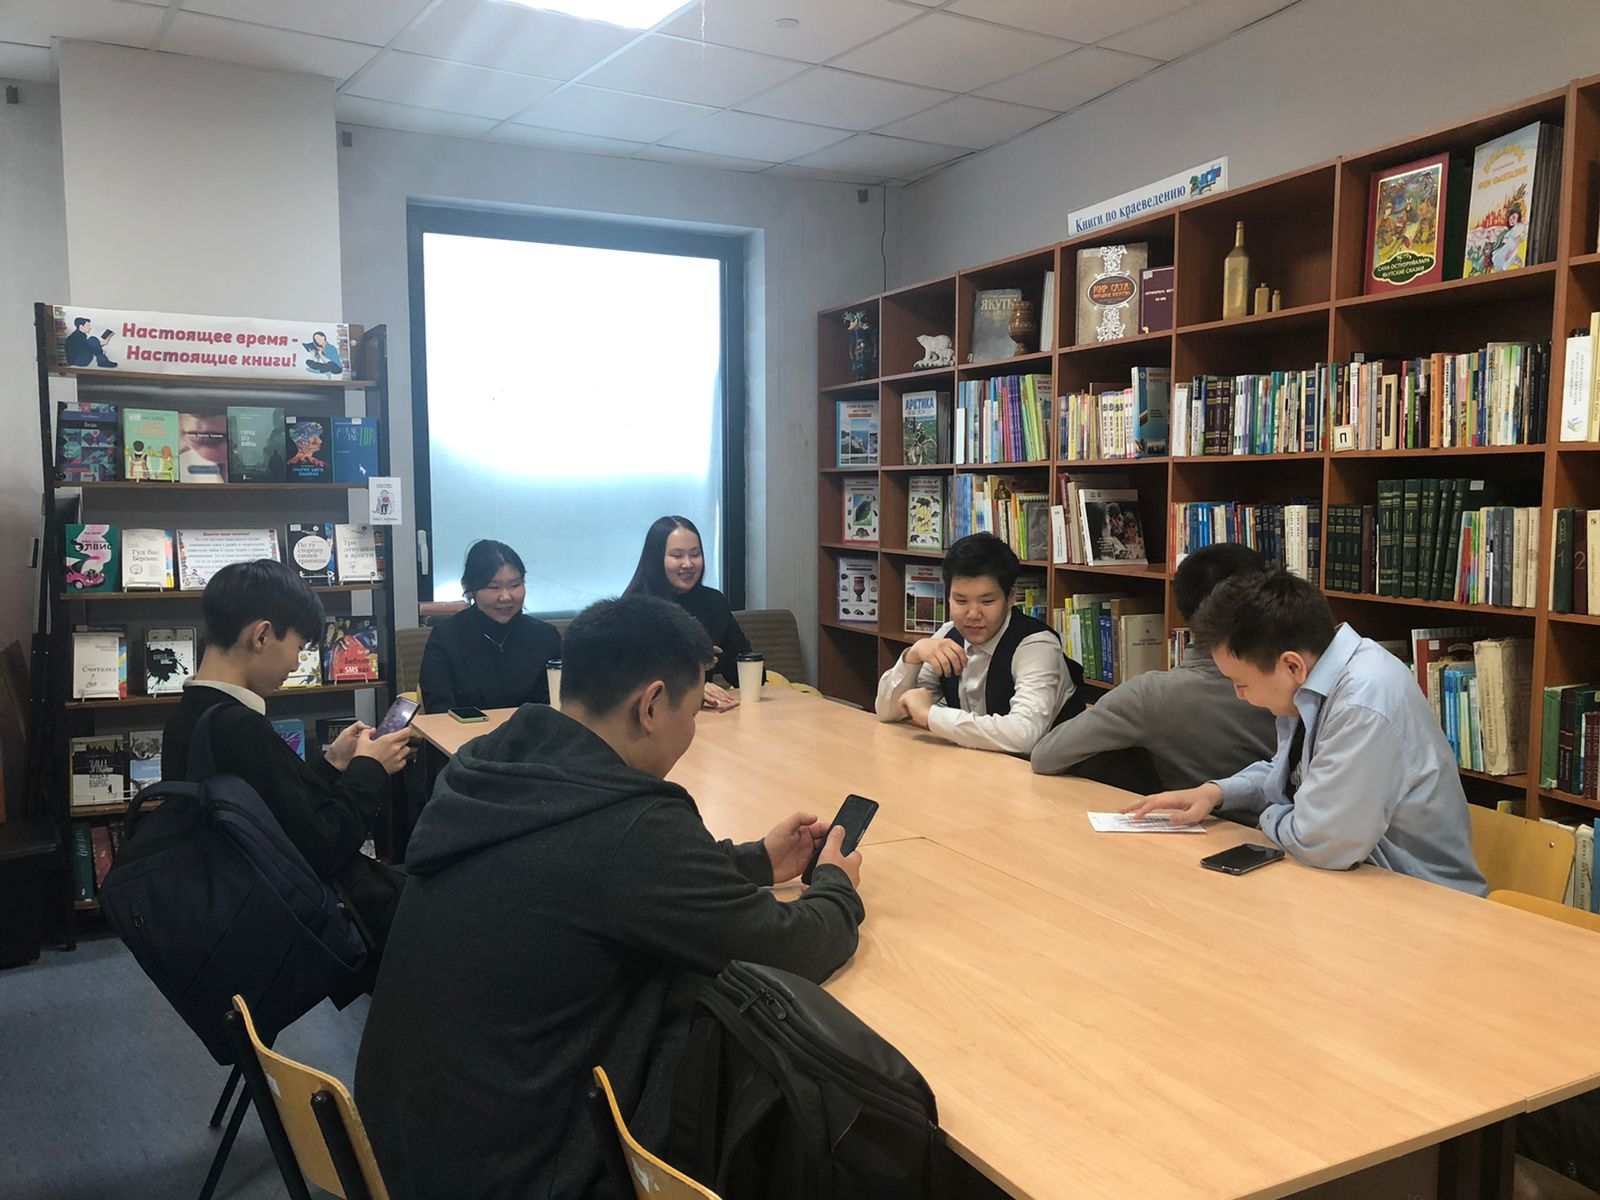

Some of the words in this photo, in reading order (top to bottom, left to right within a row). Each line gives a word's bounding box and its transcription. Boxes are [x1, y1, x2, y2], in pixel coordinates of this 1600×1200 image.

[1075, 215, 1103, 232] Книги
[1106, 212, 1117, 224] по
[1119, 185, 1186, 218] краеведению
[121, 322, 232, 344] Настоящее
[236, 332, 288, 347] время
[126, 345, 237, 367] Настоящие
[241, 353, 297, 368] книги!
[906, 397, 935, 410] АРКТИКА
[1340, 432, 1347, 443] П
[1575, 550, 1586, 570] 2
[82, 665, 117, 673] Считалка
